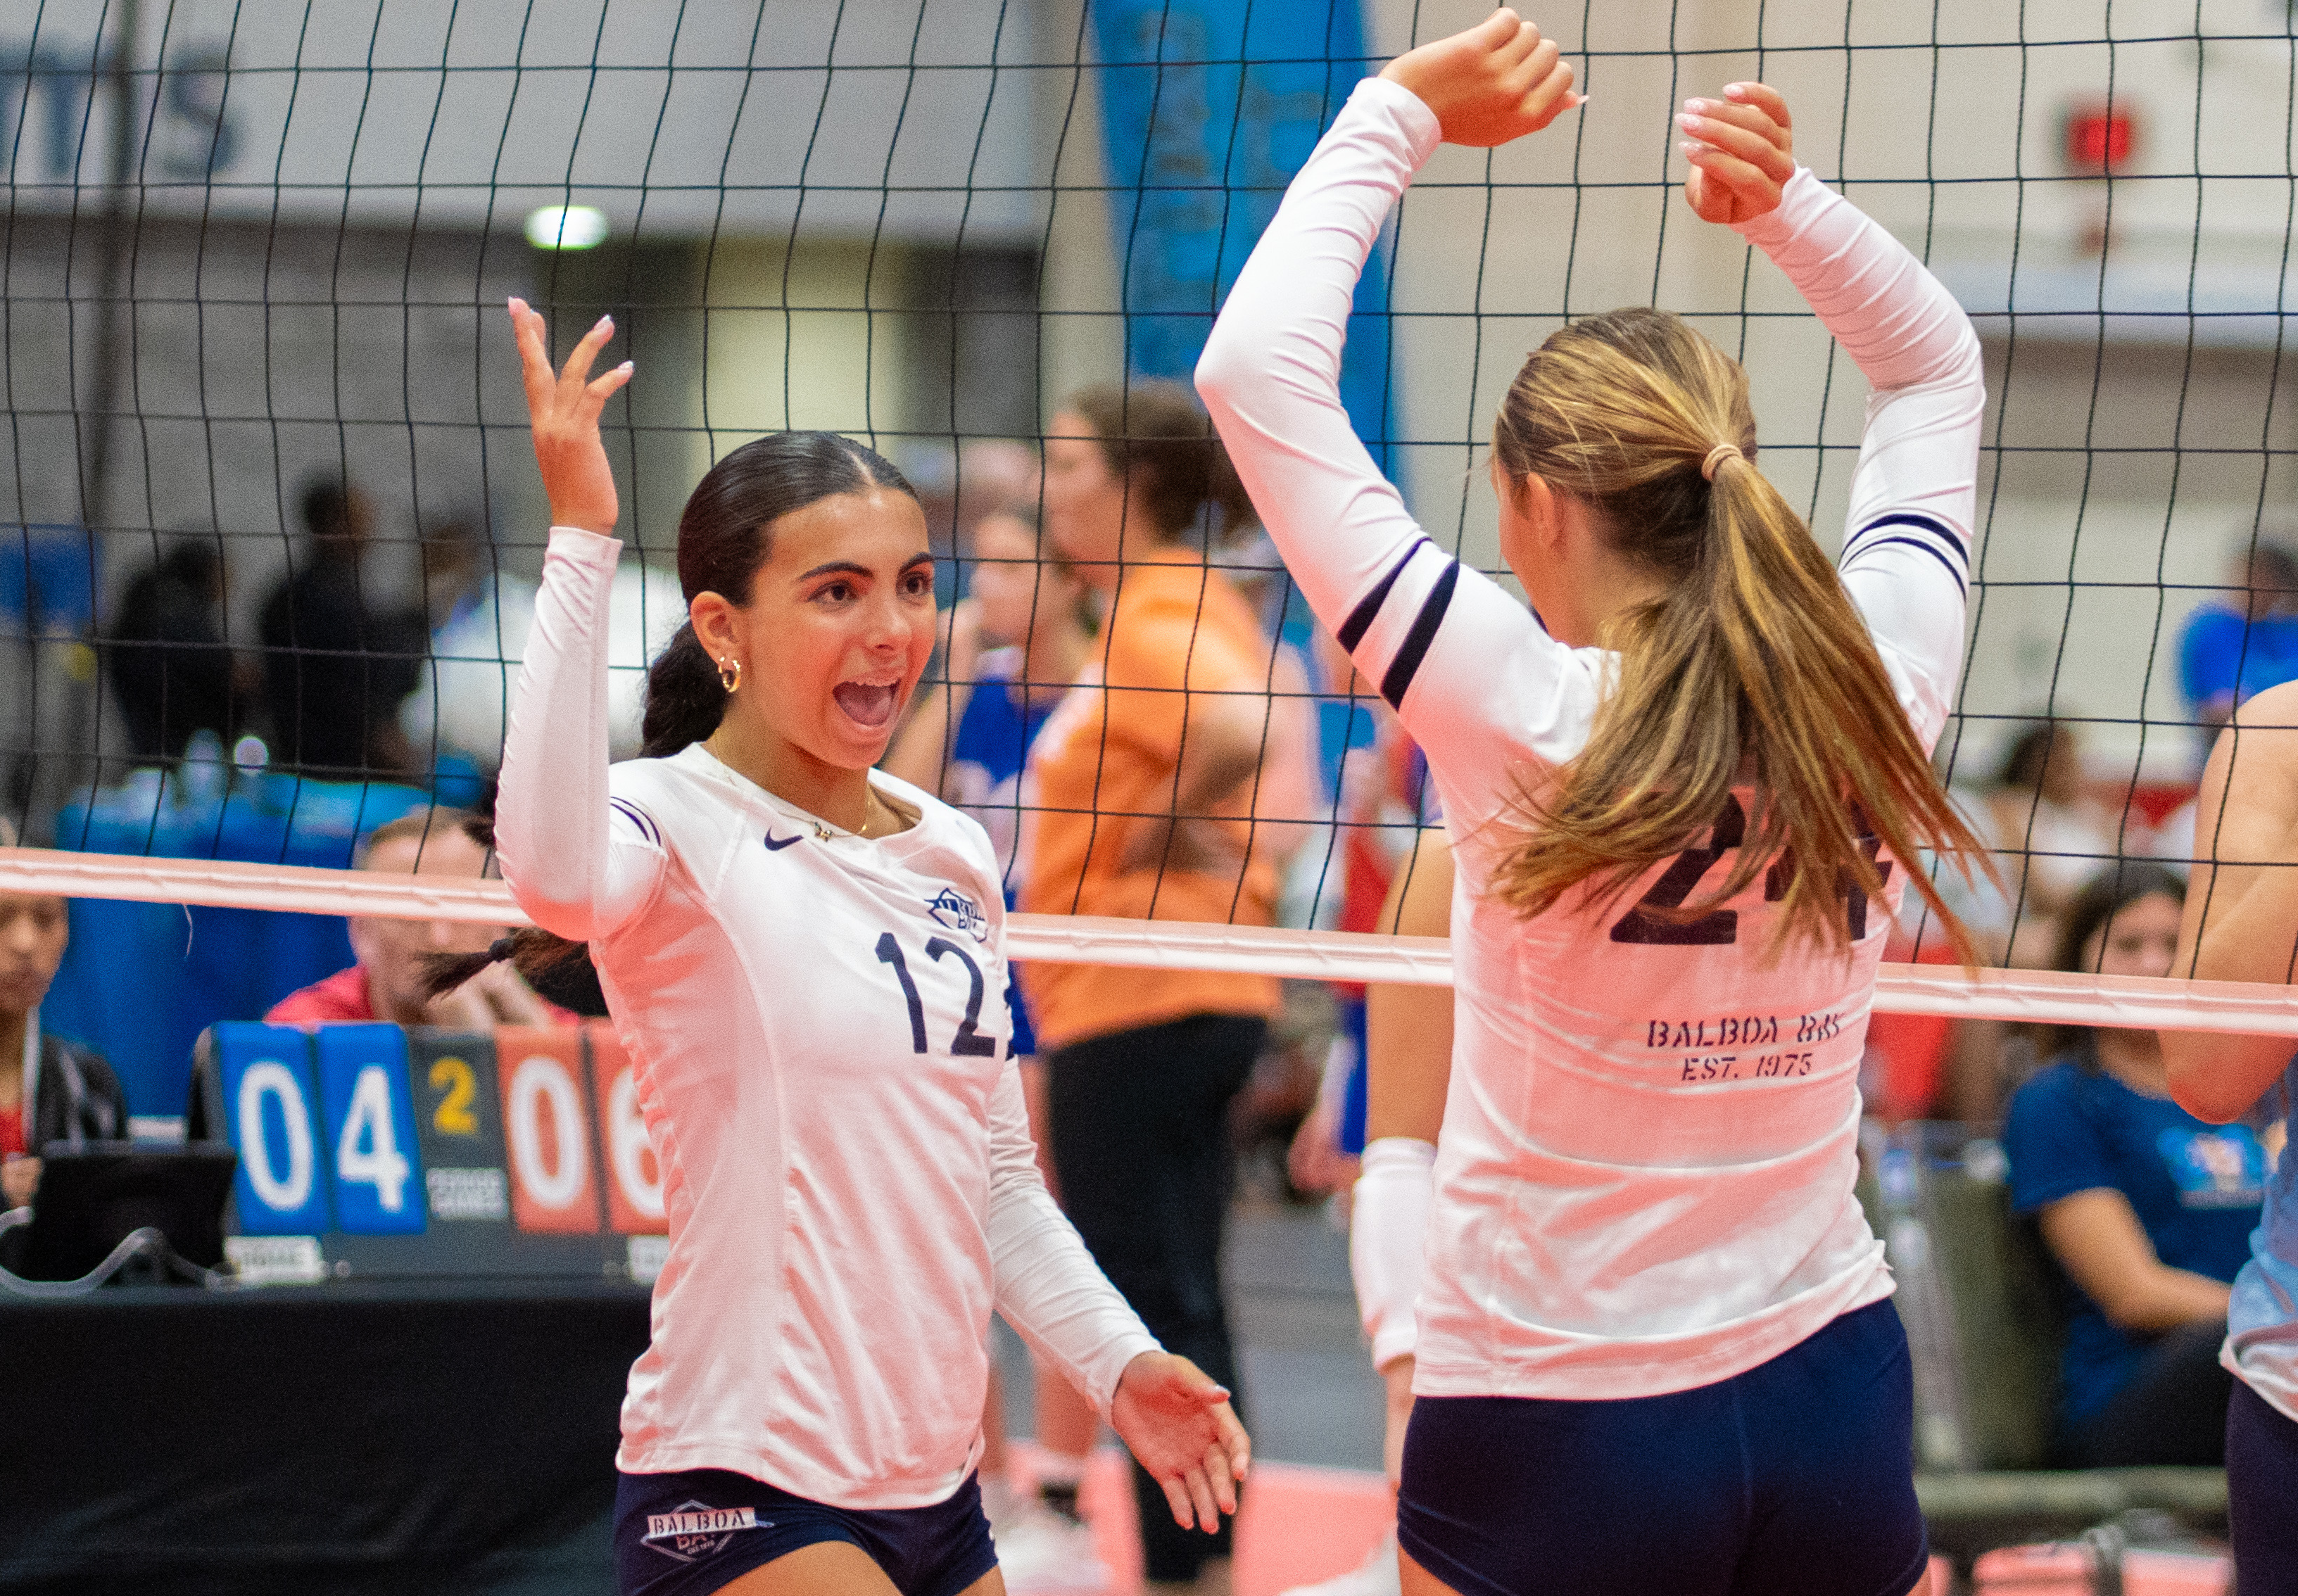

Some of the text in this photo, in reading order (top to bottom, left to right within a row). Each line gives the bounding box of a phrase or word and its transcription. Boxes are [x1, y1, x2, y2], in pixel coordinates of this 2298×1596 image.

[875, 932, 996, 1058] 12
[1647, 1015, 1778, 1049] BALBOA
[1681, 1052, 1814, 1082] EST. 1975
[427, 1056, 479, 1135] 2
[653, 1509, 745, 1535] BALBOA
